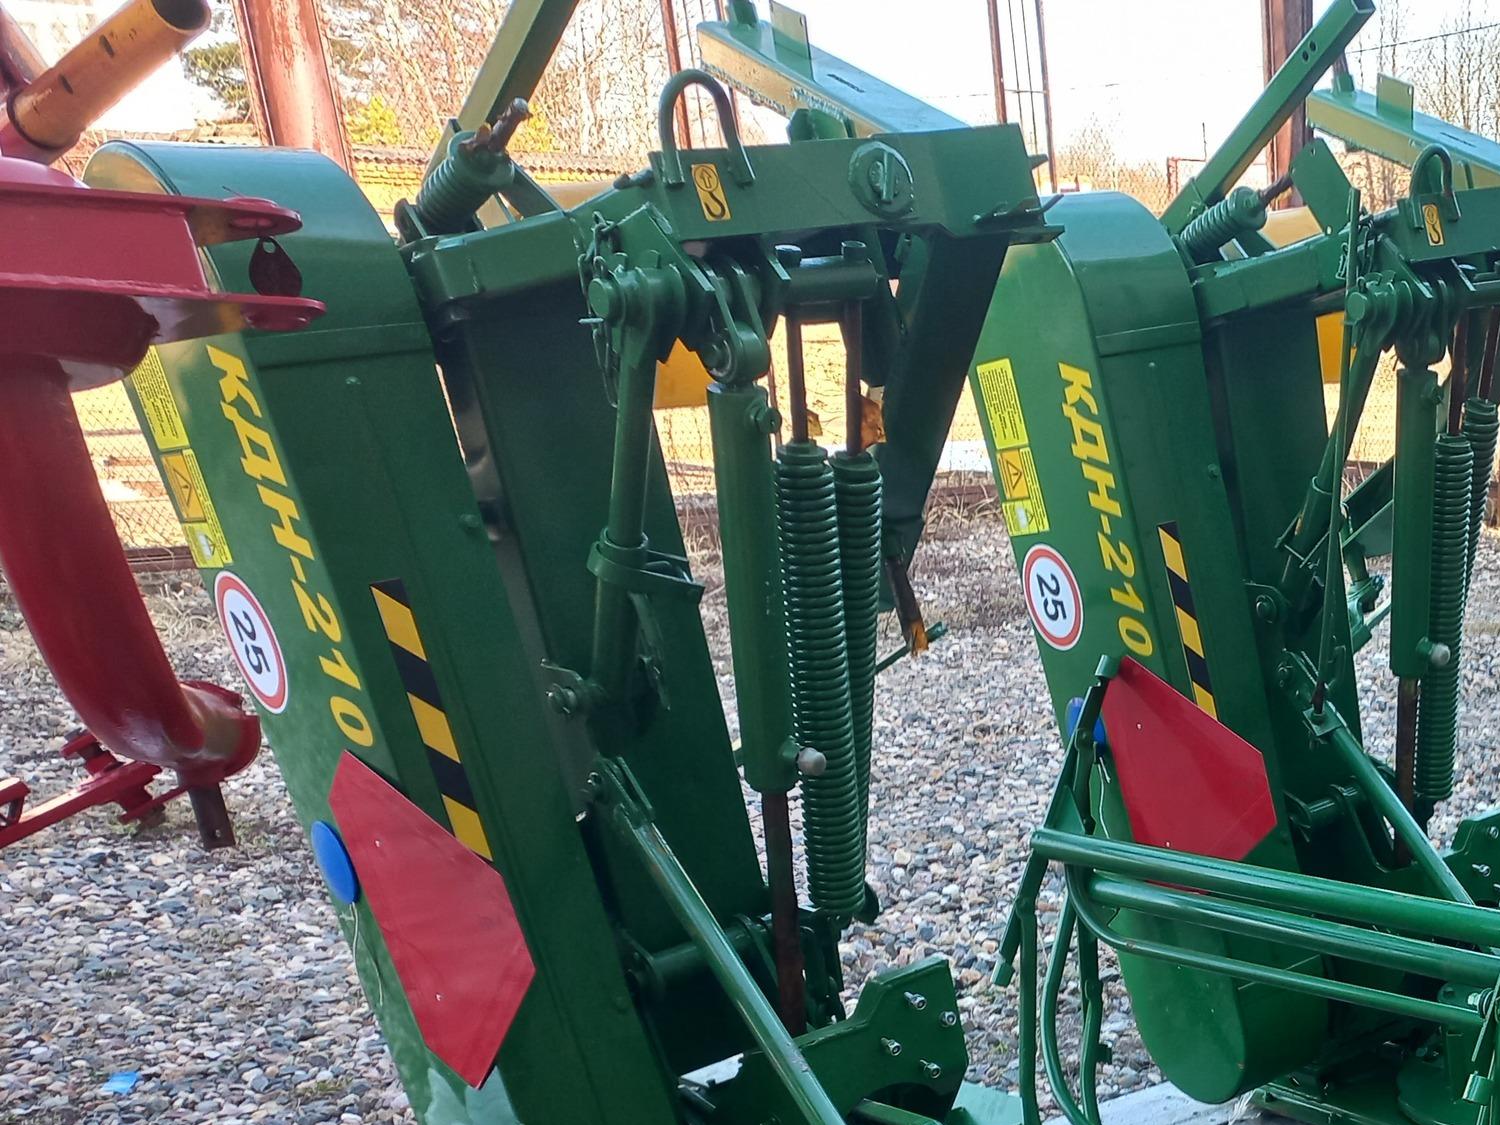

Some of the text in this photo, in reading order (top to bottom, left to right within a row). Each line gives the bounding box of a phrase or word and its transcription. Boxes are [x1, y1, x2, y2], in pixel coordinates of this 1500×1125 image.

[206, 344, 374, 748] КДН-210
[1036, 572, 1067, 622] 25
[1058, 362, 1154, 657] КДН-210
[231, 609, 270, 676] 25
